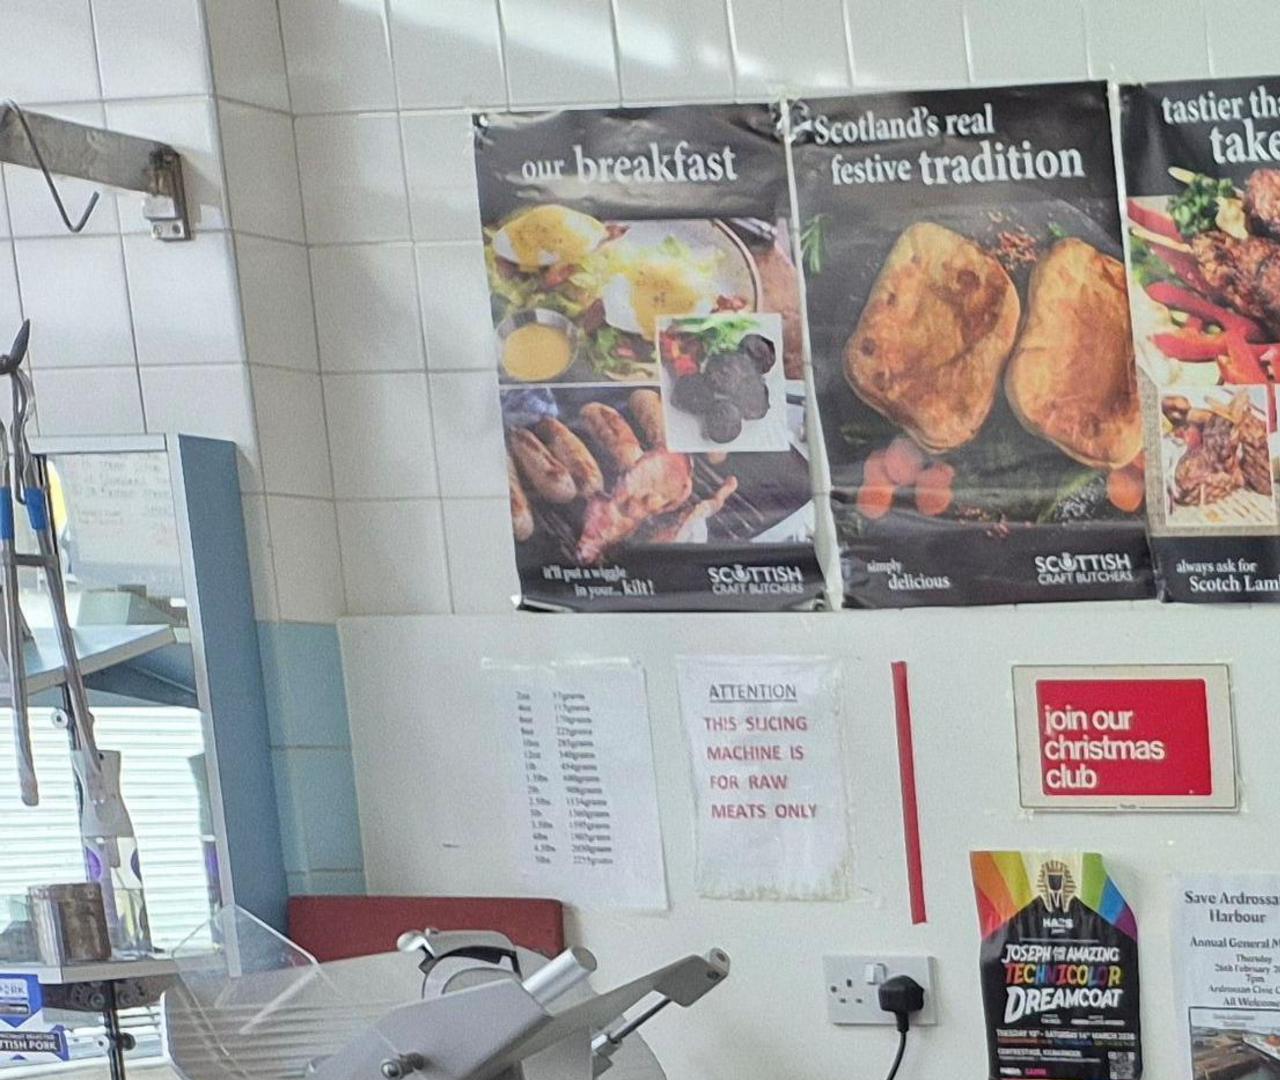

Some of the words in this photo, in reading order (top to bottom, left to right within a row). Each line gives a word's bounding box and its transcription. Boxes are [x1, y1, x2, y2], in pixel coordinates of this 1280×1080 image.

[1161, 90, 1244, 125] tastier
[814, 107, 940, 144] Scotland's
[946, 104, 994, 136] real
[522, 155, 566, 181] our
[575, 142, 737, 183] breakfast
[831, 153, 911, 185] festive
[918, 141, 1085, 185] tradition
[867, 559, 901, 575] simply
[1035, 553, 1132, 573] SCOTTISH
[1176, 559, 1214, 575] always
[1216, 559, 1236, 573] ask
[1237, 558, 1257, 573] for
[708, 564, 802, 583] SCOTTISH
[889, 574, 950, 590] delicious
[1038, 573, 1074, 585] CRAFT
[1076, 570, 1133, 583] BUTCHERS
[622, 579, 655, 597] kilt!
[712, 583, 748, 595] CRAFT
[750, 582, 804, 594] BUTCHERS
[1190, 577, 1240, 593] Scotch
[708, 683, 798, 700] ATTENTION
[703, 715, 738, 732] THIS
[745, 715, 808, 732] SLICING
[1045, 705, 1088, 736] join
[1092, 709, 1133, 730] our
[706, 745, 781, 760] MACHINE
[790, 745, 805, 760] IS
[1044, 734, 1165, 760] christmas
[709, 775, 739, 790] FOR
[748, 774, 788, 790] RAW
[1046, 763, 1098, 789] club
[711, 804, 766, 819] MEATS
[775, 803, 818, 819] ONLY
[1184, 891, 1217, 906] Save
[1209, 909, 1267, 924] Harbour
[1190, 937, 1228, 948] Annual
[1229, 938, 1270, 949] General
[1001, 944, 1052, 964] JOSEPH
[1066, 946, 1119, 962] AMAZING
[1236, 953, 1272, 964] Thursday
[1005, 963, 1121, 987] TECHNICOLOR
[1234, 964, 1271, 974] February
[1209, 984, 1250, 994] Ardrossan
[1004, 986, 1123, 1024] DREAMCOAT
